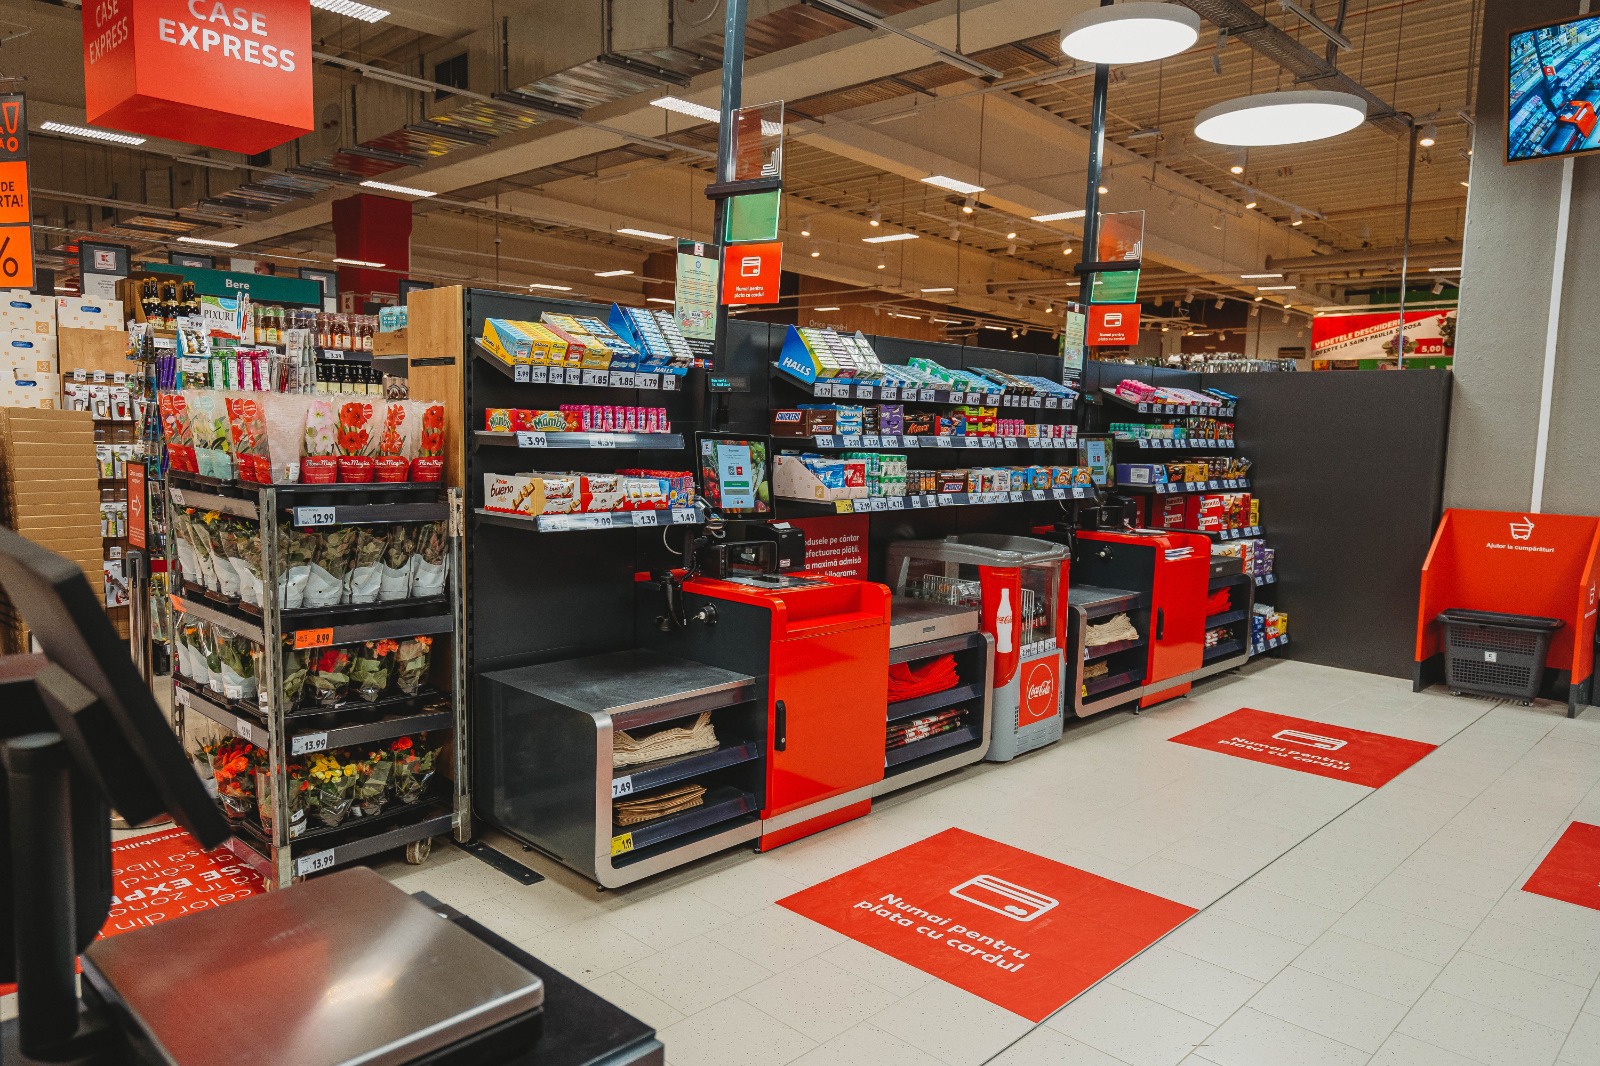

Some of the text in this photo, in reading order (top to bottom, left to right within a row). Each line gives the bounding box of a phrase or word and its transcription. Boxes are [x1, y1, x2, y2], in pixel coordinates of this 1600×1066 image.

[94, 0, 118, 28] CASE
[188, 0, 268, 37] CASE
[89, 17, 129, 65] EXPRESS
[158, 16, 296, 72] EXPRESS
[225, 278, 250, 290] Bere
[204, 309, 234, 322] PIXURI
[1314, 332, 1354, 349] VEDETELE
[1315, 346, 1339, 356] OFERTE
[1350, 336, 1369, 347] SAINT
[1370, 330, 1394, 340] PAULIA
[1421, 345, 1441, 353] 5,00
[782, 356, 812, 376] HALLS
[592, 376, 608, 385] 1.85
[618, 377, 634, 386] 1.85
[642, 378, 658, 387] 1.79
[490, 413, 511, 429] Mamba
[532, 415, 566, 432] Mamba
[908, 422, 930, 434] Mars
[528, 437, 545, 446] 3.99
[490, 484, 514, 498] bueno
[312, 513, 334, 524] 12.99
[641, 515, 656, 524] 1.39
[681, 513, 695, 522] 1.49
[812, 559, 838, 569] maximă
[839, 556, 862, 565] admisă
[316, 634, 330, 644] 8.99
[1028, 680, 1051, 700] Coca-Cola
[304, 738, 326, 750] 13.99
[1230, 737, 1350, 766] Numai pentru
[1218, 740, 1264, 752] plata
[1293, 754, 1350, 771] cardul
[613, 782, 630, 795] 7.49
[312, 854, 334, 870] 13.99
[120, 864, 195, 889] când
[115, 889, 252, 930] celor din
[878, 894, 1030, 960] Numai pentru
[853, 900, 1025, 973] plata cu cardul
